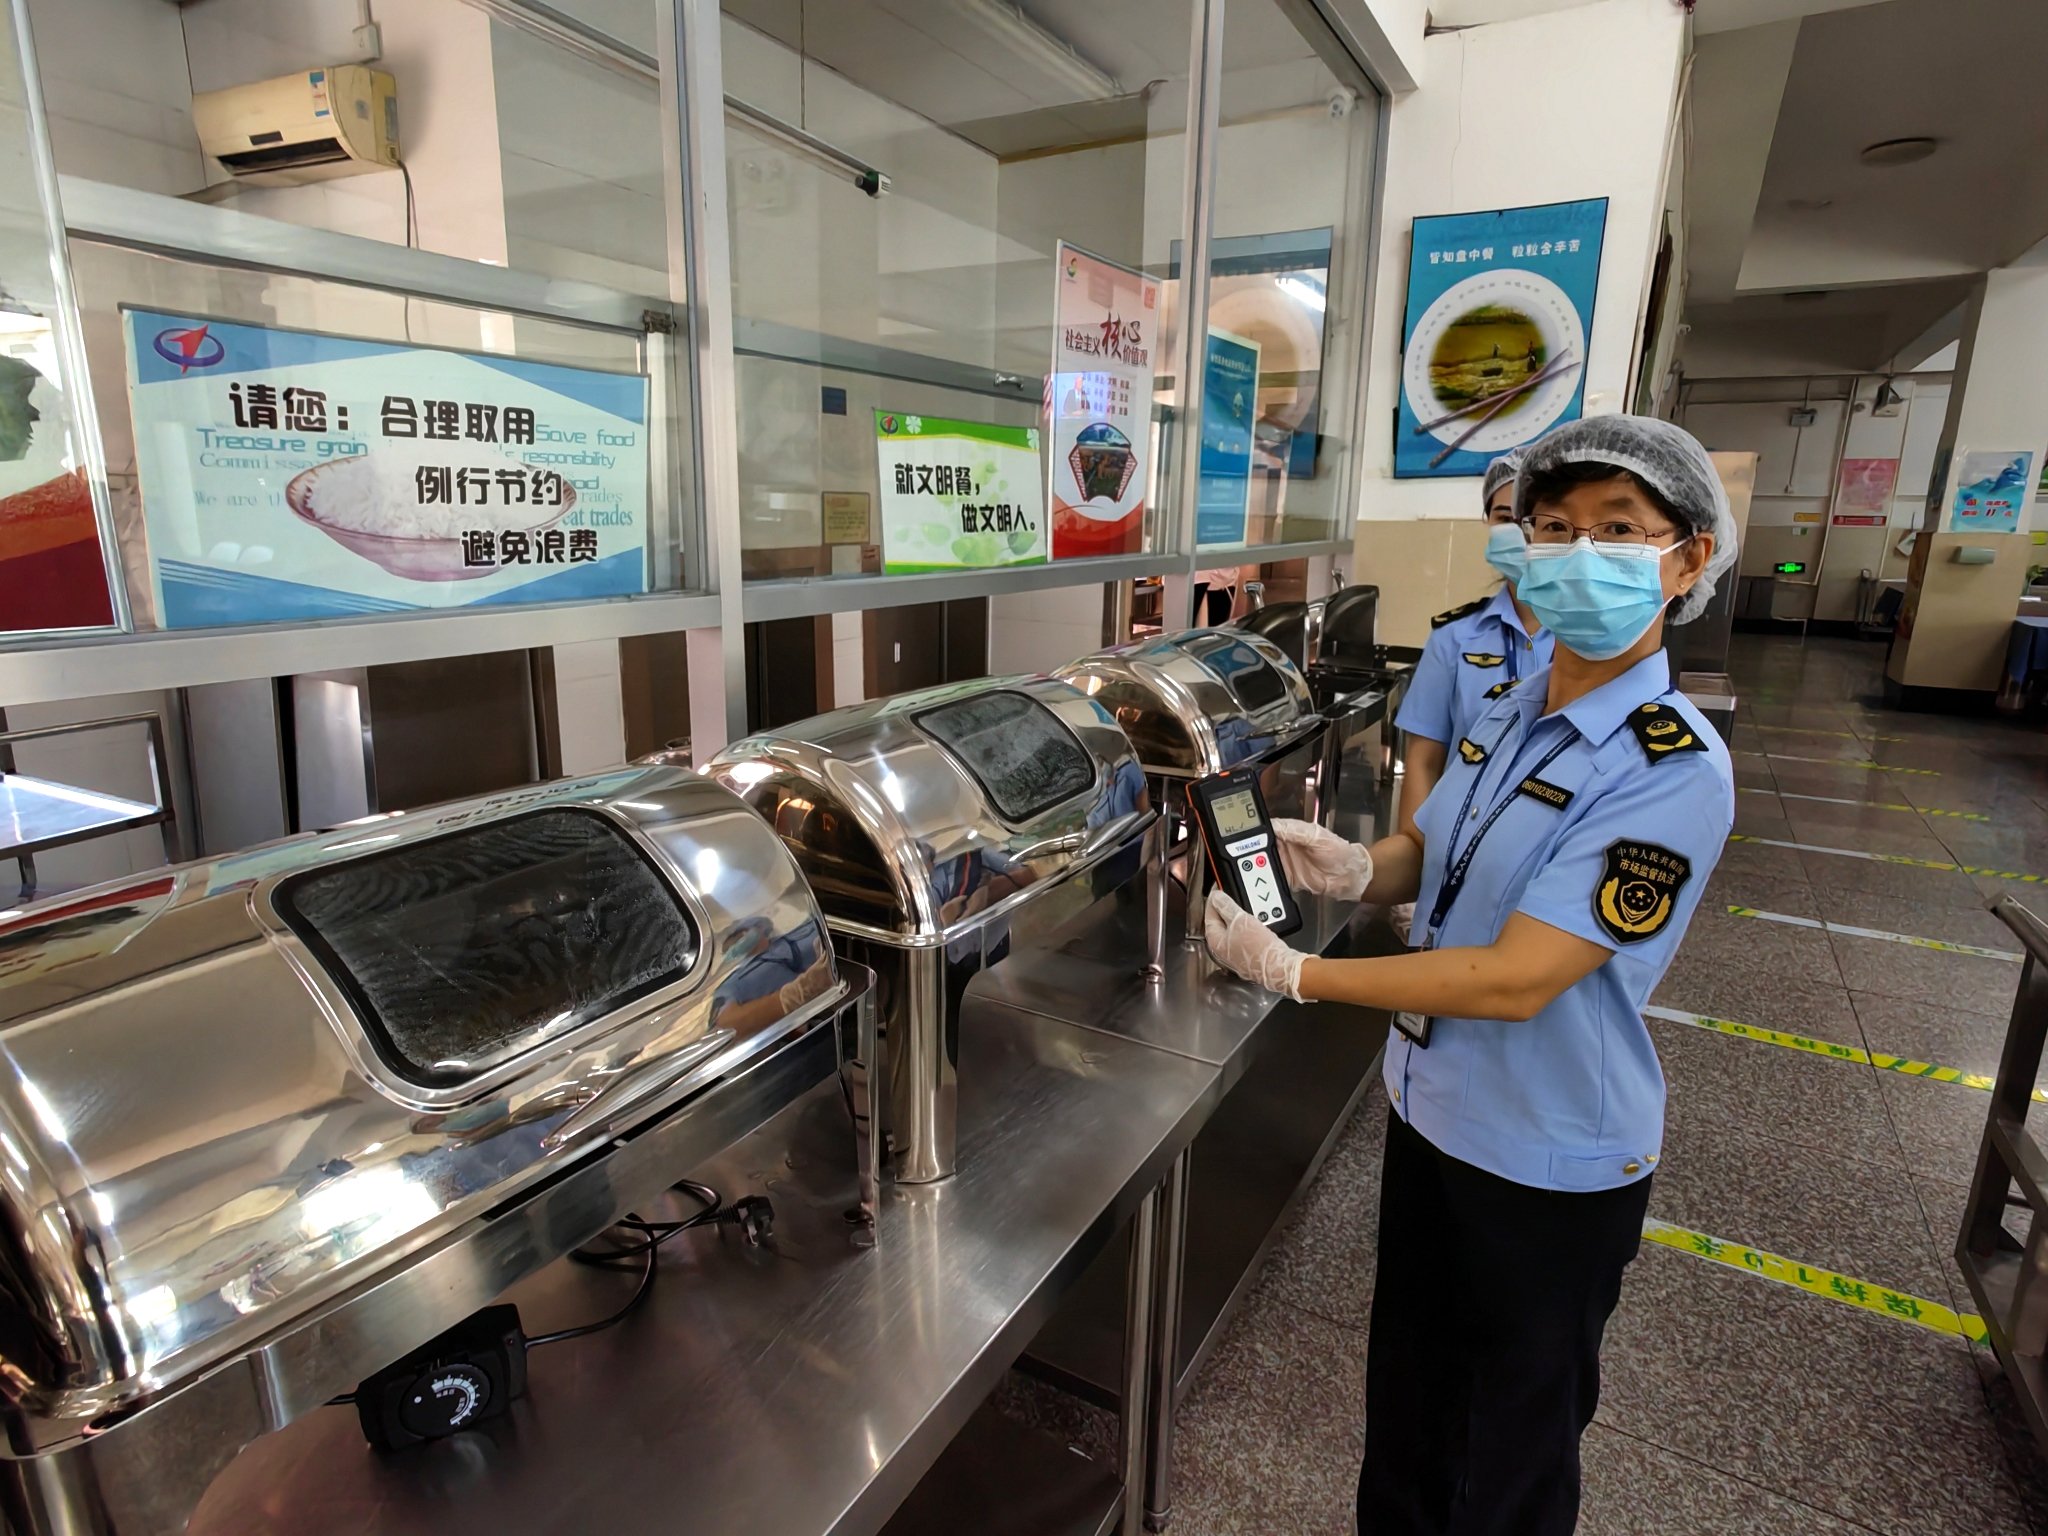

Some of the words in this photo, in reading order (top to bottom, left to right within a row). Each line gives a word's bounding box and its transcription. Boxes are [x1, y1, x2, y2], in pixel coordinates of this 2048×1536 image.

[196, 428, 306, 452] Treasure
[316, 439, 369, 457] grain
[535, 424, 587, 444] Save
[597, 429, 635, 446] food
[415, 466, 563, 505] 例行节约
[589, 504, 634, 527] trades
[461, 531, 598, 568] 避免浪费
[1246, 803, 1256, 819] 6
[1617, 846, 1686, 876] 中华人民共和国
